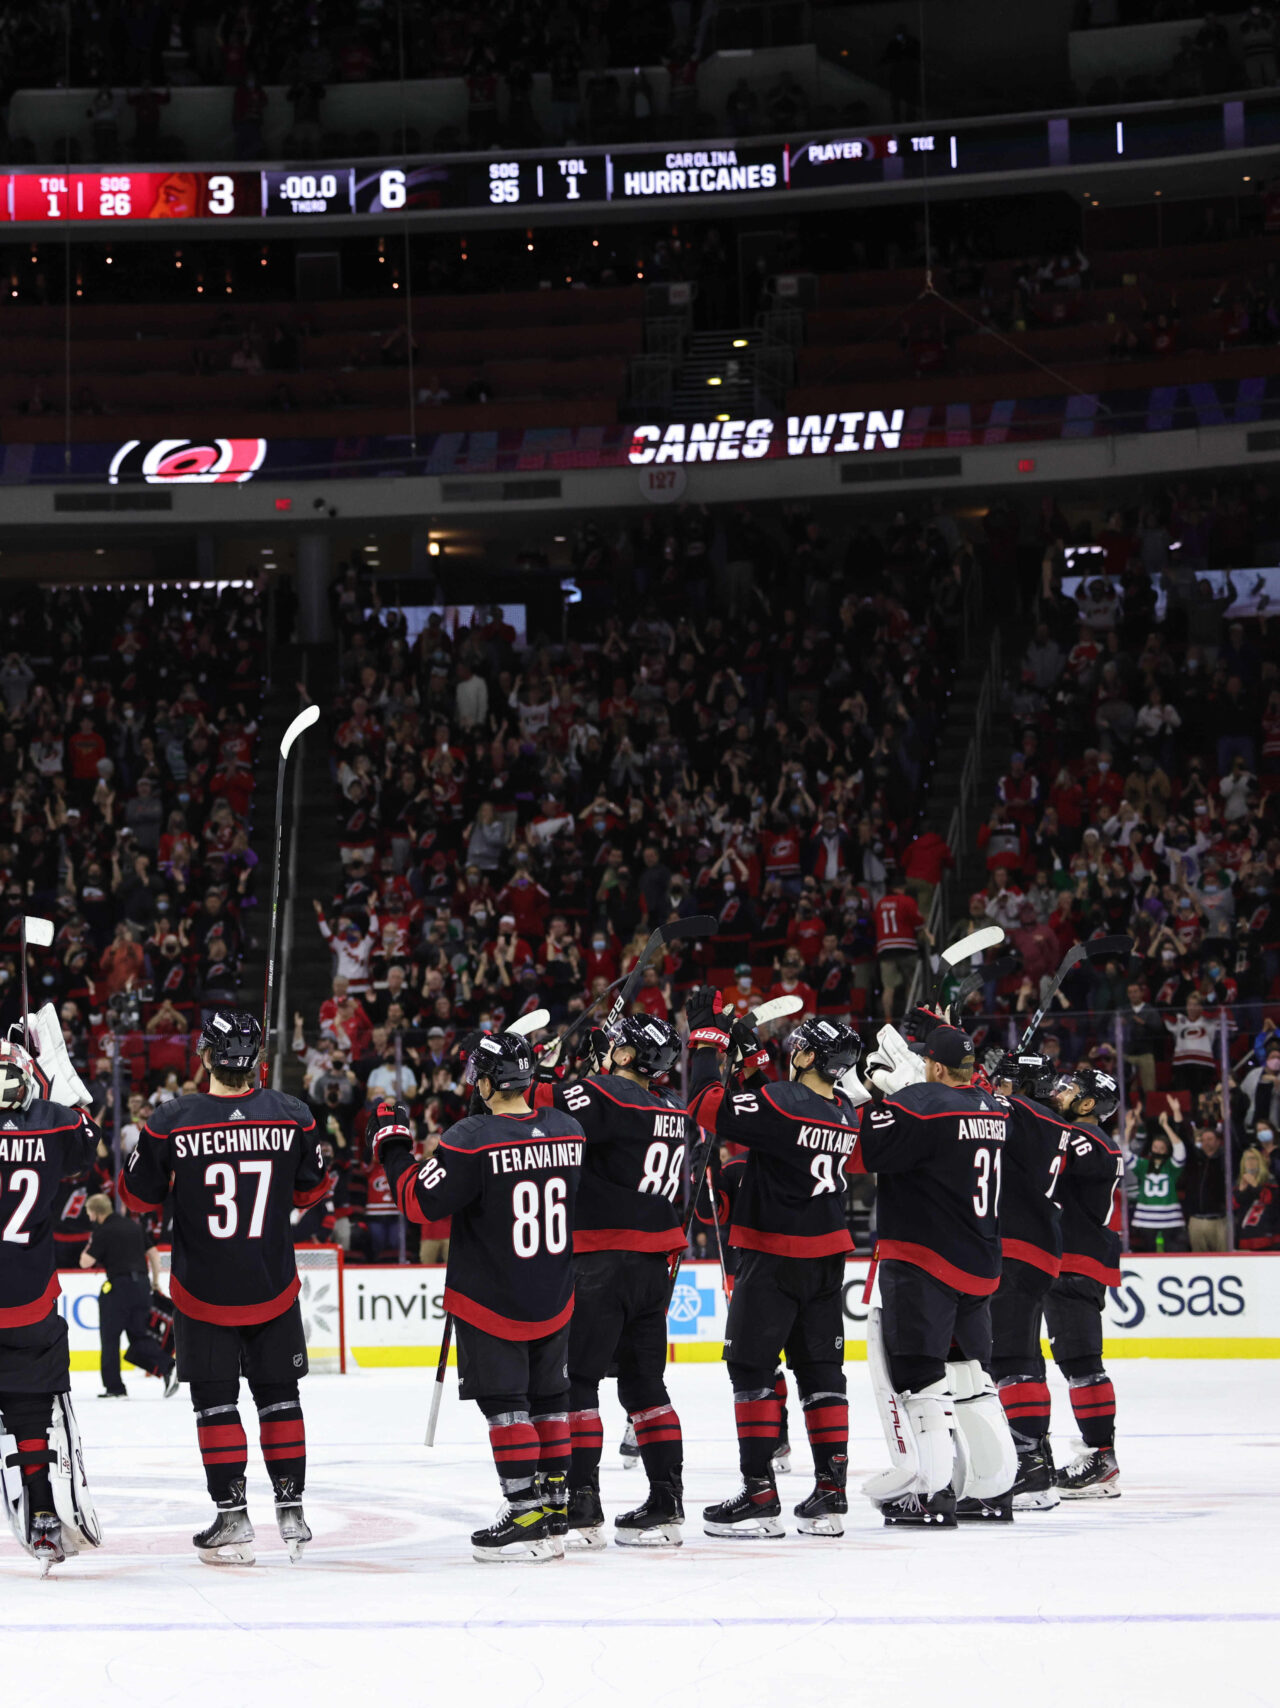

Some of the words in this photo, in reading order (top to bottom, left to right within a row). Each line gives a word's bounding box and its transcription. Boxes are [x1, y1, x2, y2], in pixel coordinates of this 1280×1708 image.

[666, 150, 737, 169] CAROLINA
[809, 141, 862, 163] PLAYER
[489, 162, 519, 179] SOG
[557, 158, 588, 176] TOL
[39, 177, 68, 193] TOL
[100, 176, 131, 192] SOG
[279, 174, 337, 200] :00.0
[379, 170, 407, 209] 6
[489, 179, 519, 203] 35
[566, 176, 580, 199] 1
[624, 163, 777, 196] HURRICANES
[46, 194, 61, 217] 1
[99, 193, 131, 216] 26
[208, 175, 235, 214] 3
[628, 418, 774, 465] CANES
[787, 408, 905, 456] WIN
[695, 1030, 731, 1050] AUER
[237, 1056, 250, 1067] 37
[518, 1057, 529, 1070] 86
[562, 1084, 591, 1111] 88
[732, 1093, 759, 1116] 82
[870, 1110, 895, 1129] 31
[175, 1128, 296, 1158] SVECHNIKOV
[1071, 1135, 1093, 1157] 16
[489, 1142, 583, 1174] TERAVAINEN
[418, 1157, 446, 1190] 86
[972, 1147, 1002, 1218] 31
[204, 1159, 273, 1239] 37
[512, 1176, 567, 1258] 86
[1157, 1274, 1245, 1317] sas
[888, 1393, 907, 1454] TRUE
